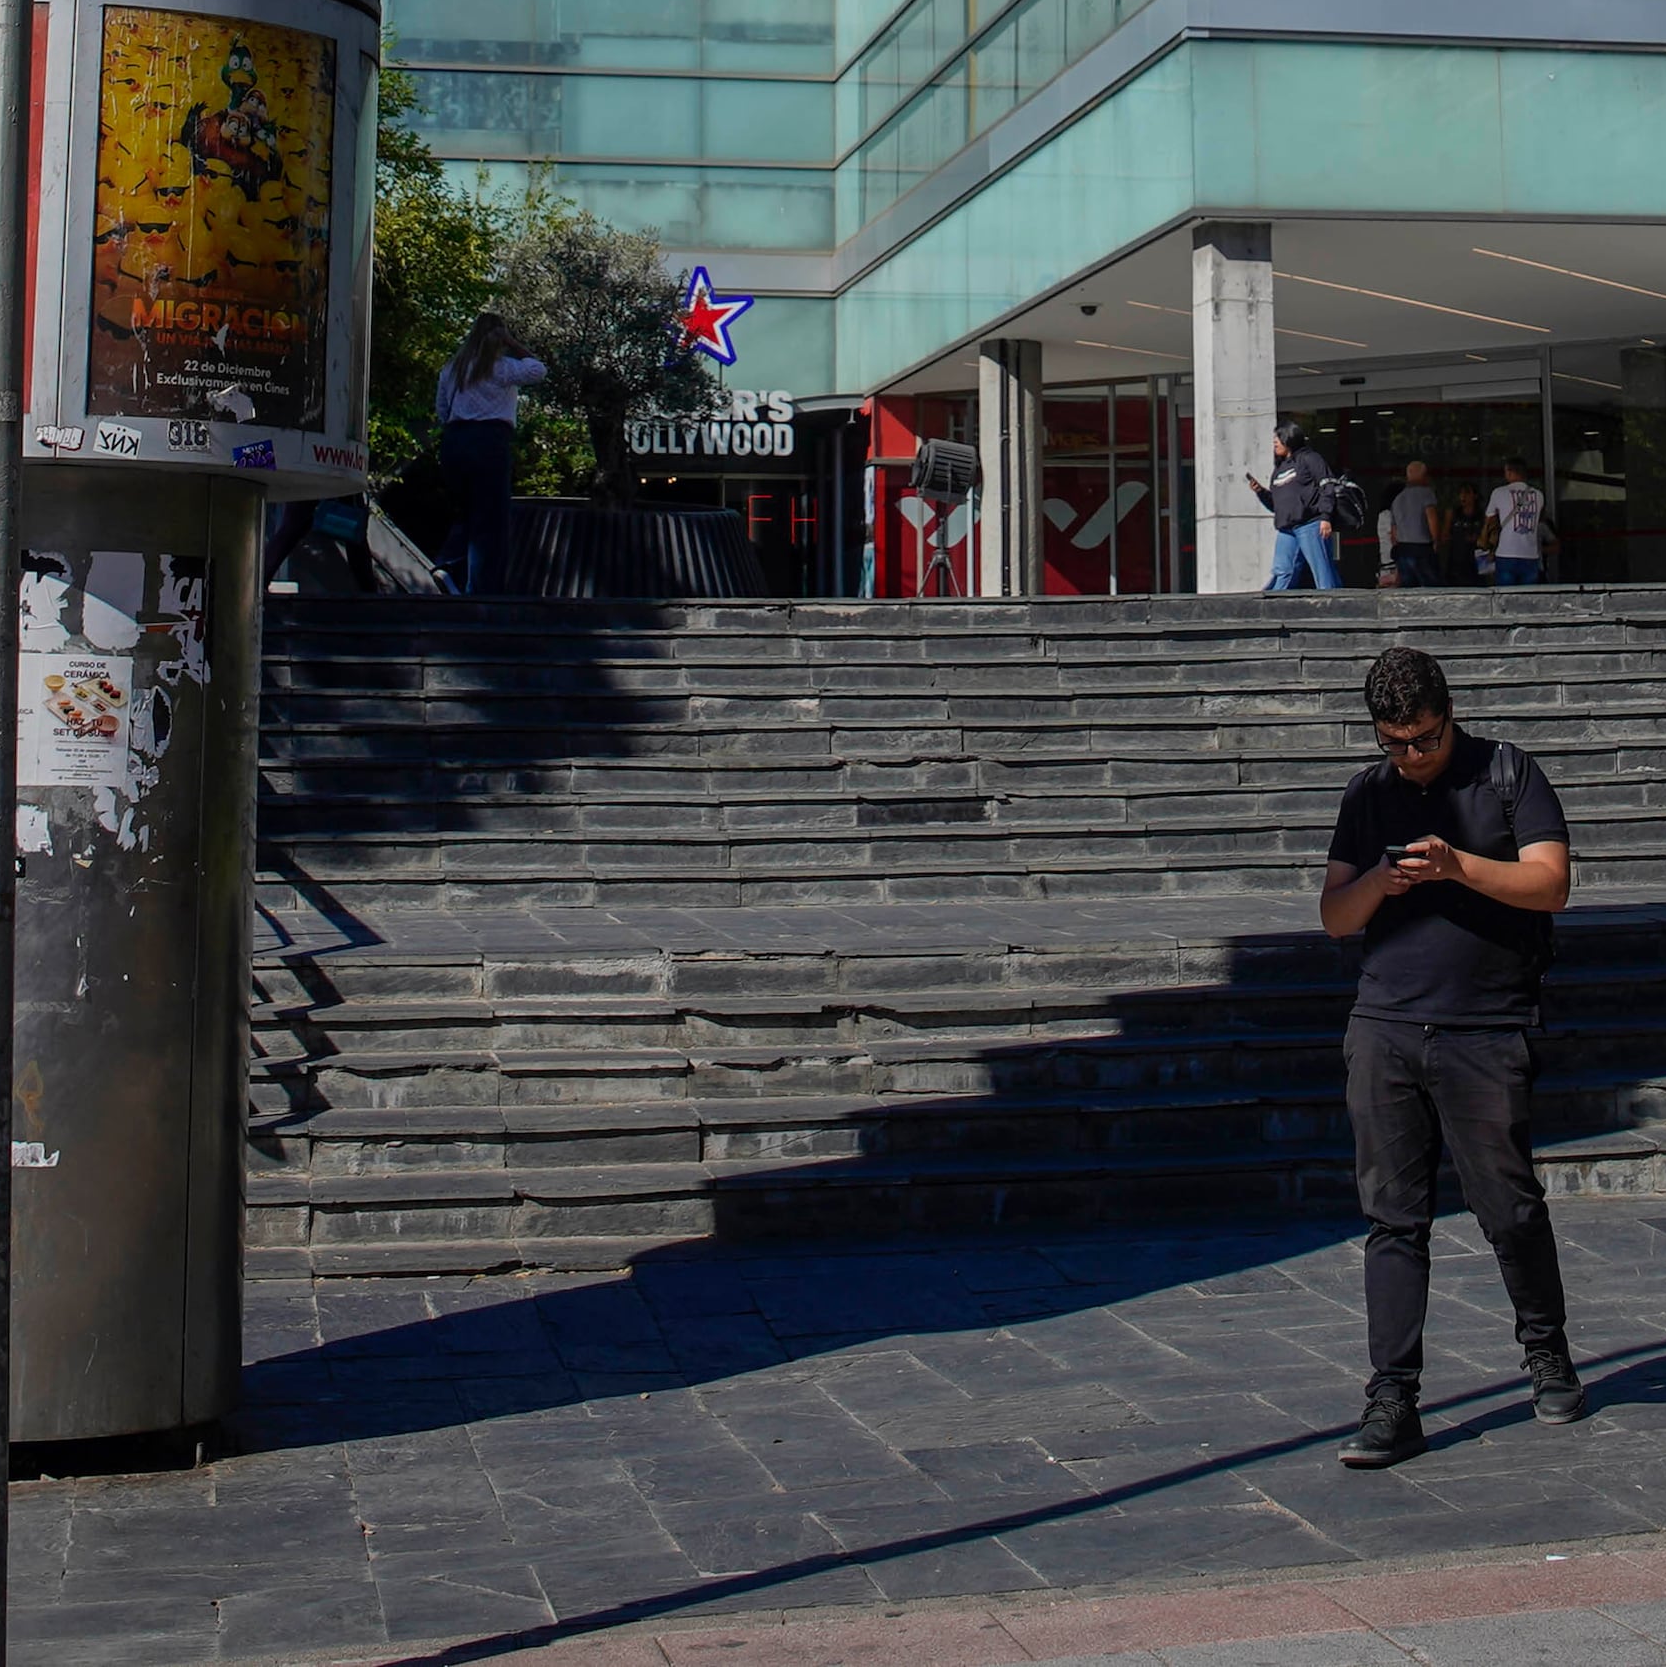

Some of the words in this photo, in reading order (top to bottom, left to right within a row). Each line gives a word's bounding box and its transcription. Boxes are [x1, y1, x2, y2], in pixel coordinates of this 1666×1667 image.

[131, 297, 307, 342] MIGRACIÓN
[183, 358, 199, 373] 22
[200, 359, 216, 374] de
[217, 361, 272, 379] Diciembre
[250, 381, 263, 392] en
[264, 381, 290, 396] Cines
[69, 661, 95, 669] CURSO
[96, 661, 107, 669] DE
[63, 668, 111, 679] CERÁMICA
